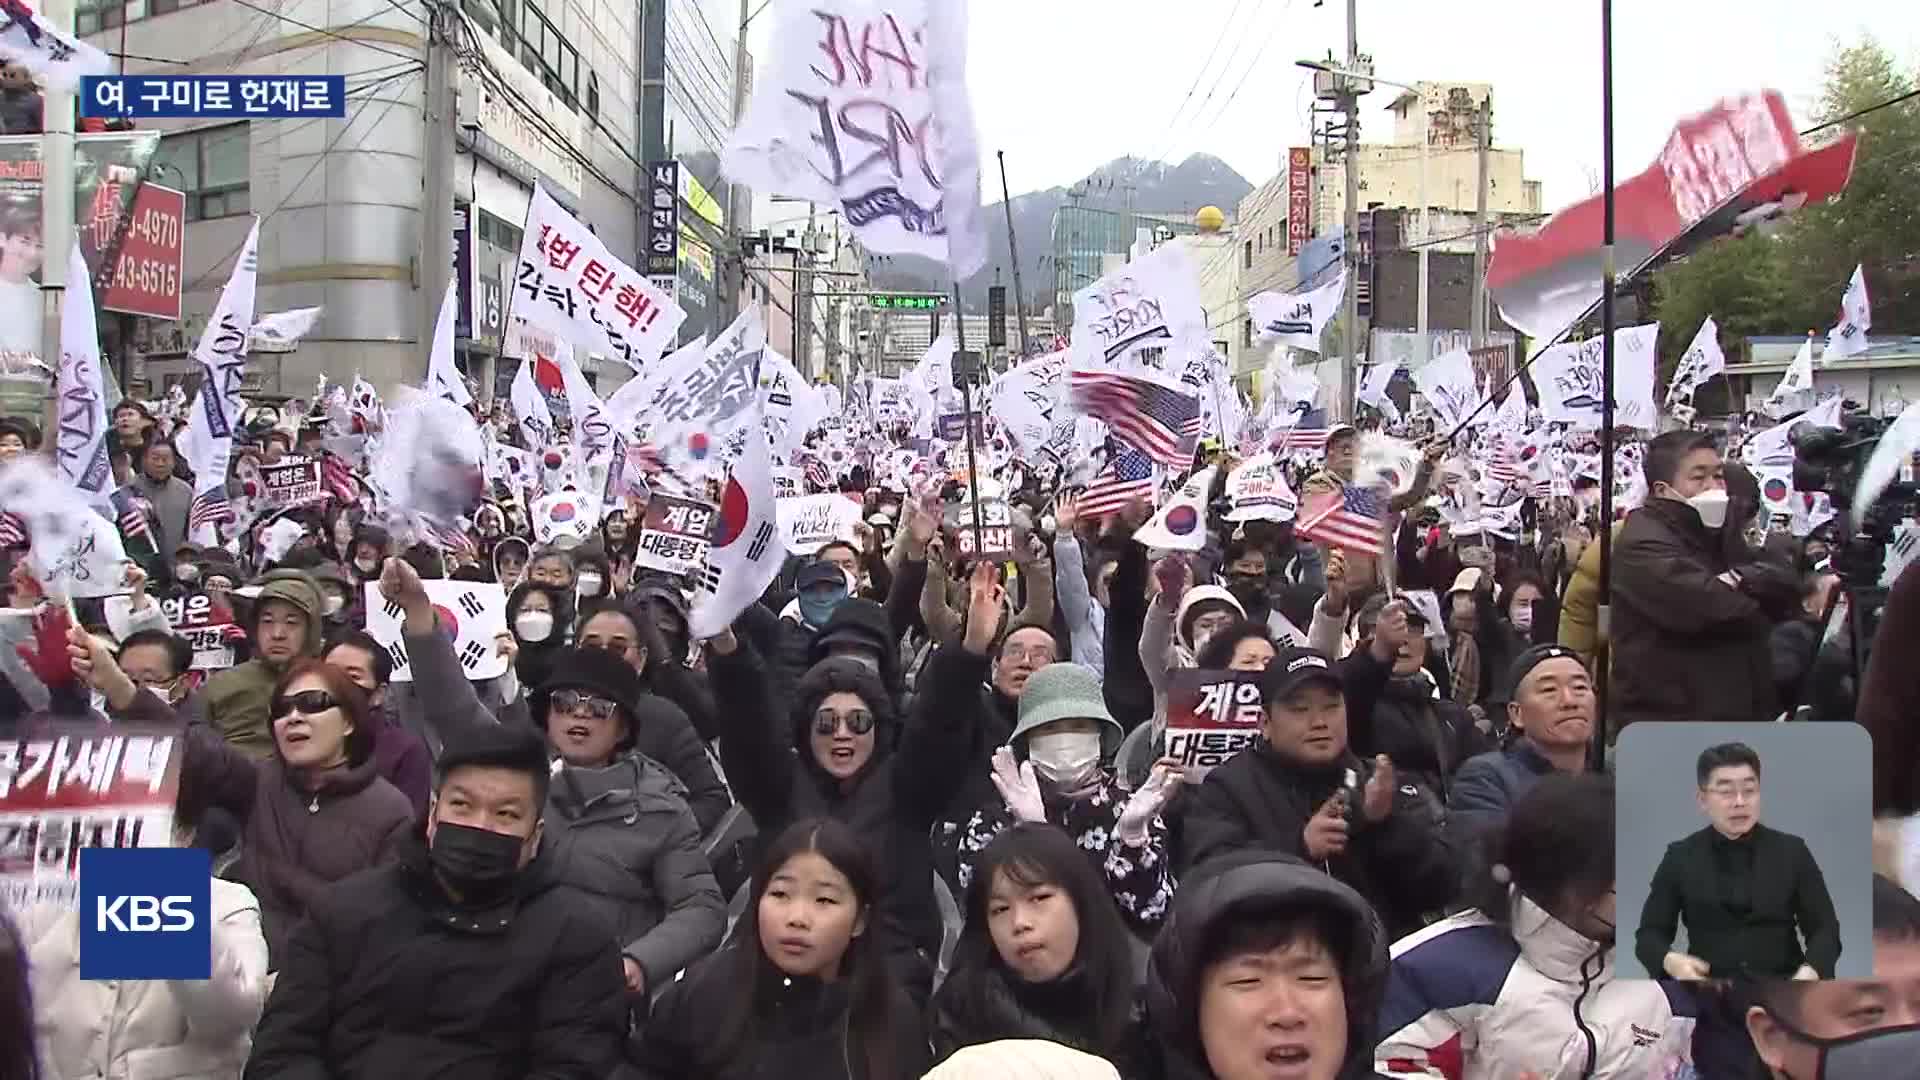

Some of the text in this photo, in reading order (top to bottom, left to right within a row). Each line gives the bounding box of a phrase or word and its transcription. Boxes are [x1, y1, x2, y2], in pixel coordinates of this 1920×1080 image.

[112, 252, 176, 298] 43-6515
[577, 258, 660, 334] 탄핵!
[662, 506, 711, 537] 계엄
[1193, 681, 1263, 723] 계엄
